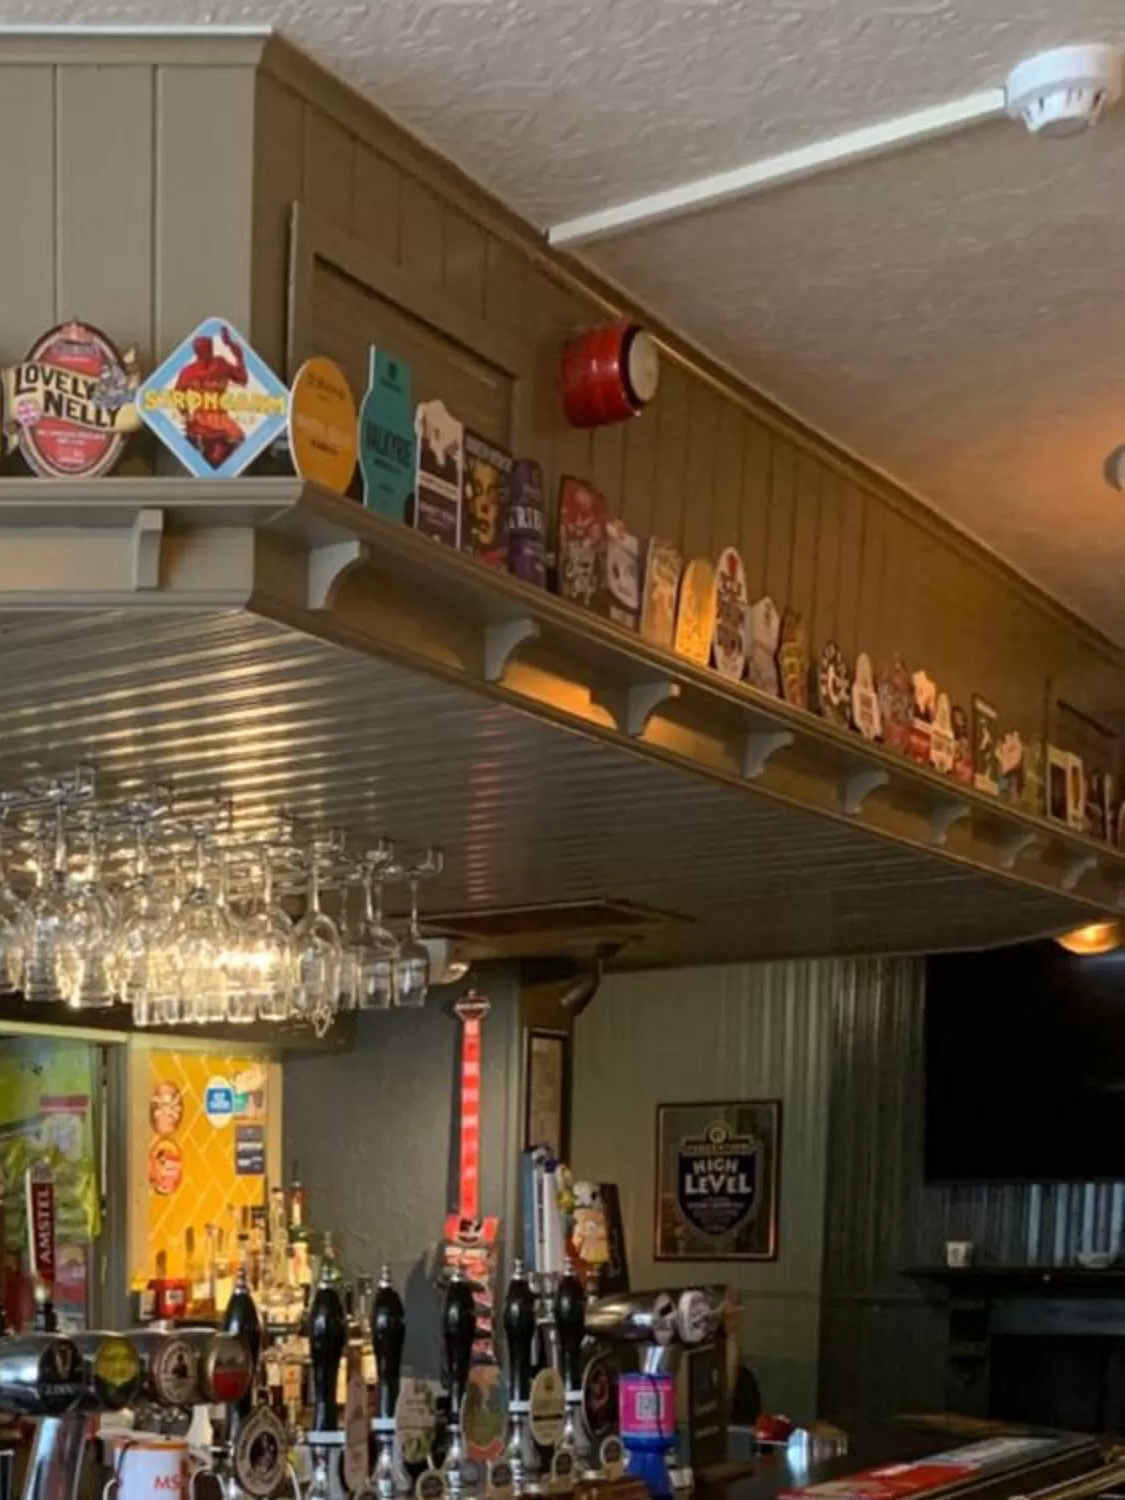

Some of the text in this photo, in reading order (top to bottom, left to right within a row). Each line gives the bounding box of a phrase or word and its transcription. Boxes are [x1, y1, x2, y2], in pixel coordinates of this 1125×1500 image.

[14, 364, 97, 398] LOVELY
[43, 391, 121, 428] NELLY
[684, 1172, 752, 1195] LEVEL
[692, 1157, 738, 1176] HIGH
[35, 1187, 53, 1265] AMSTEL
